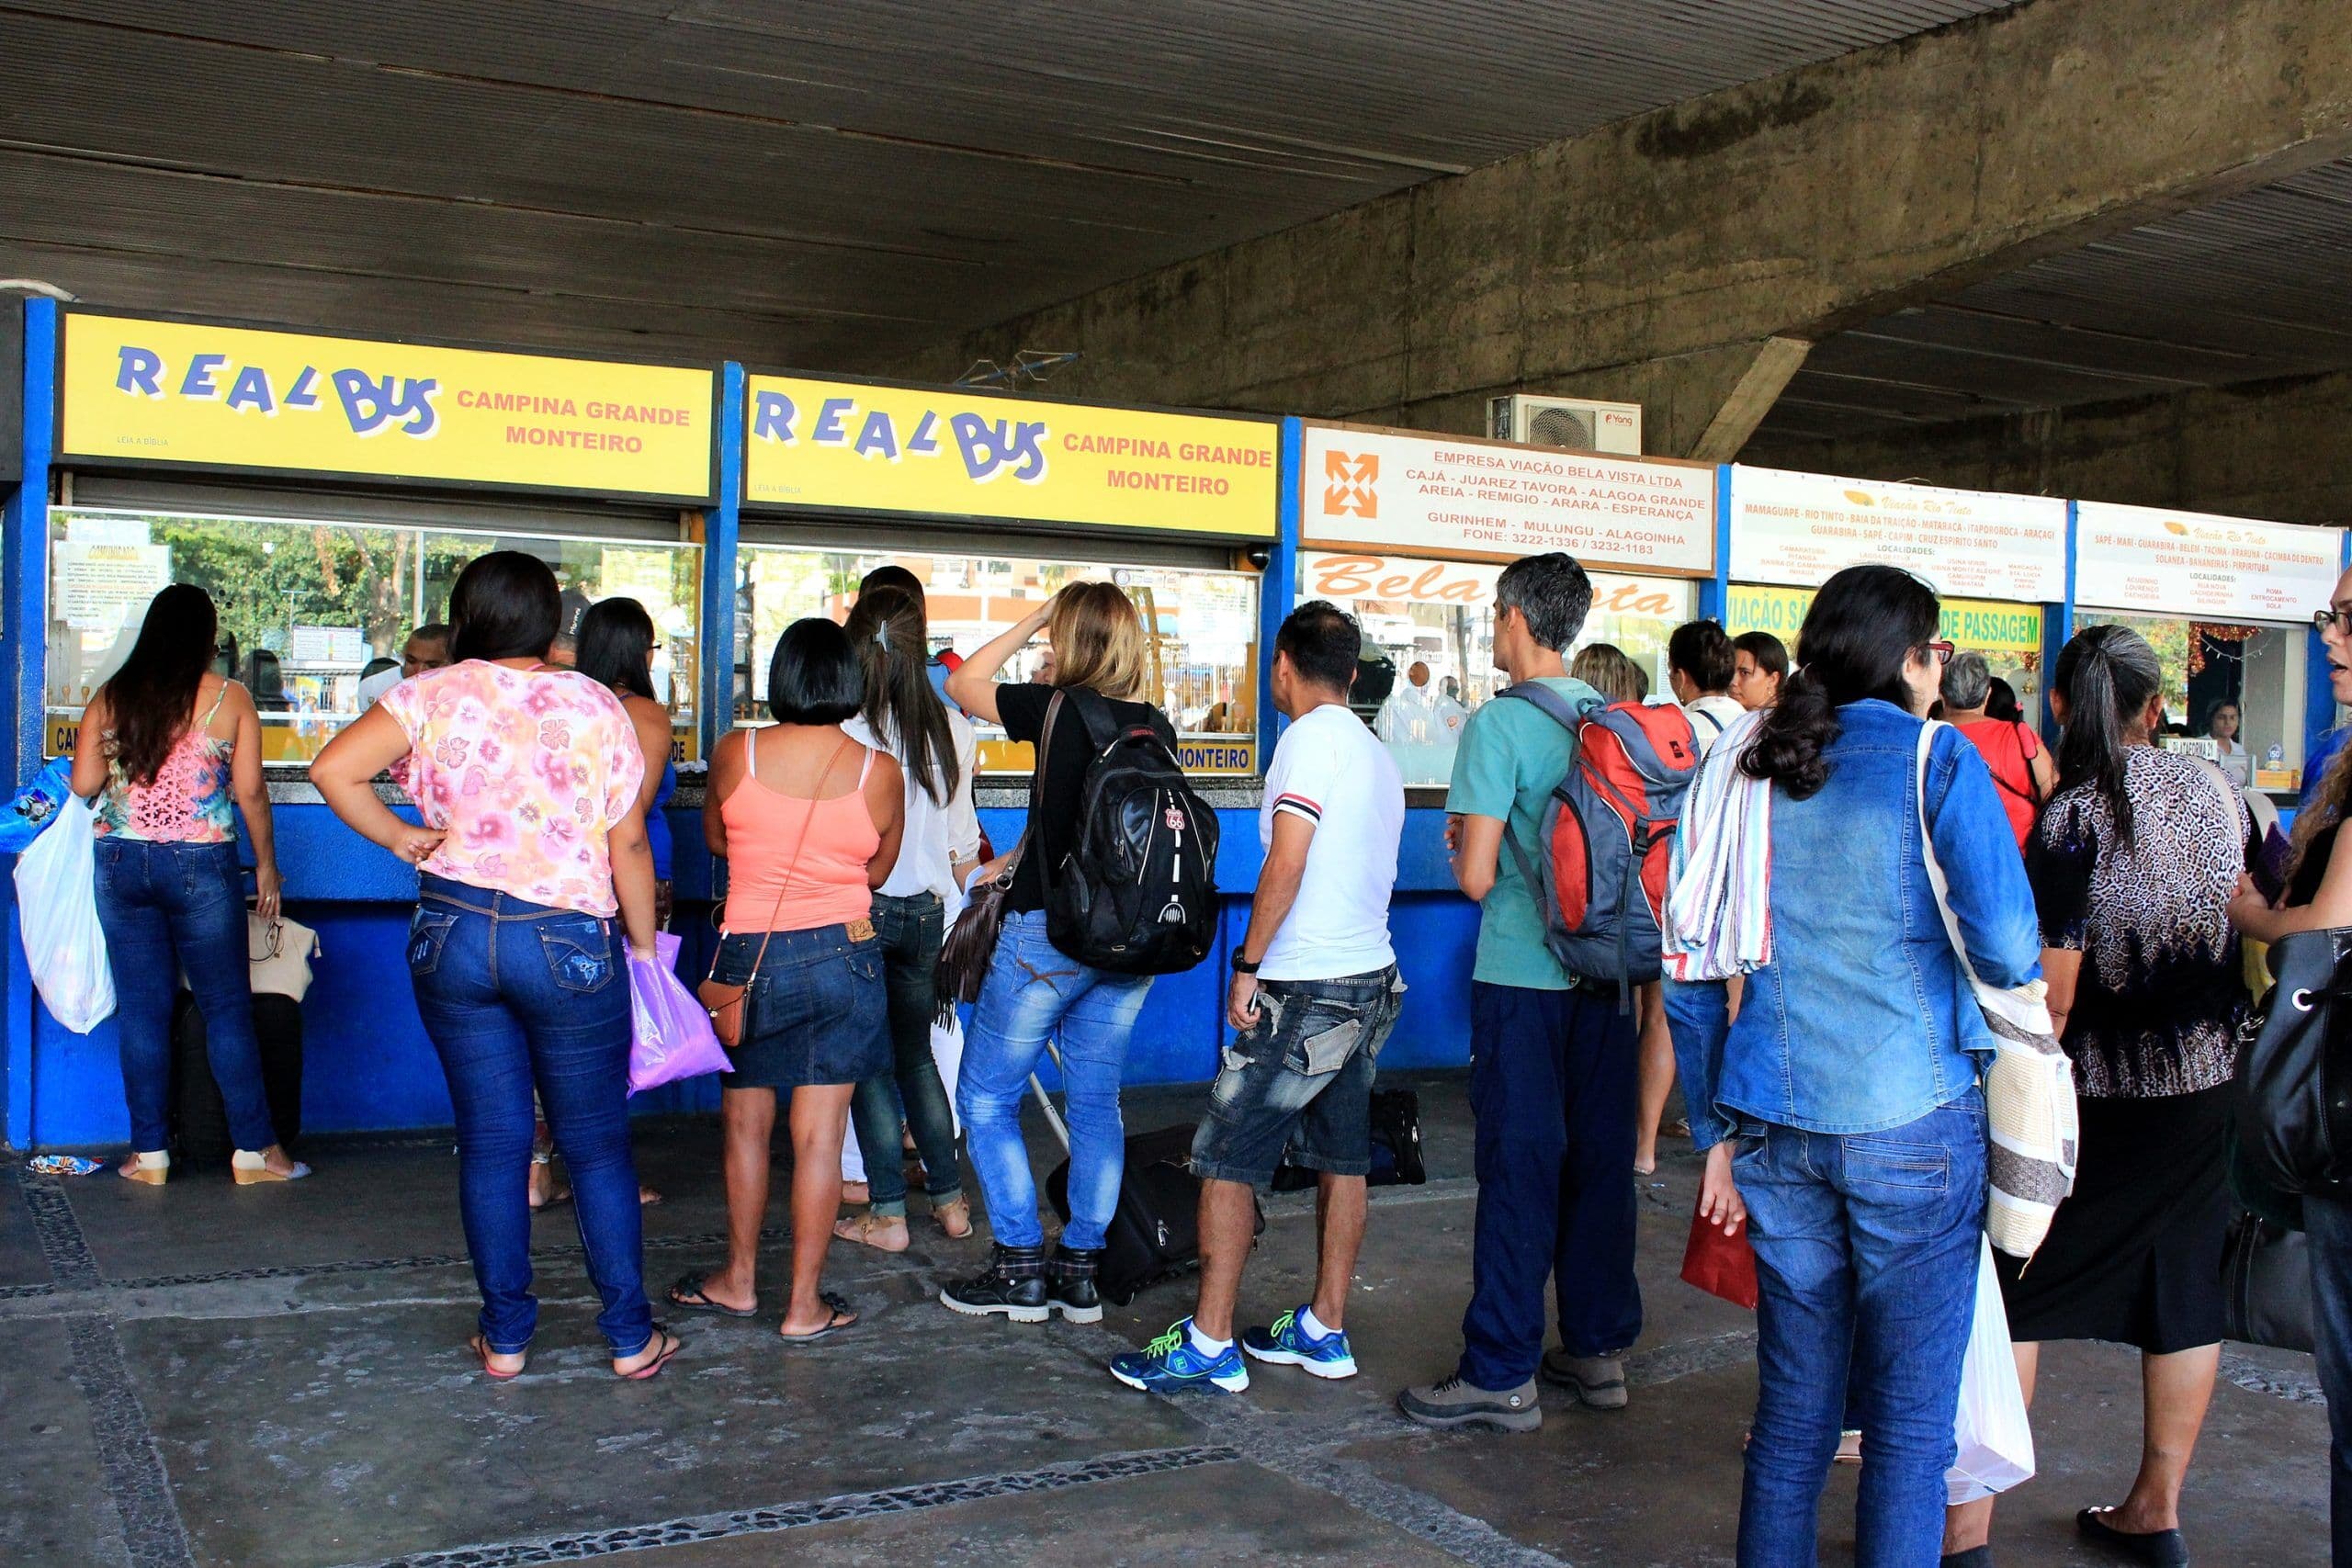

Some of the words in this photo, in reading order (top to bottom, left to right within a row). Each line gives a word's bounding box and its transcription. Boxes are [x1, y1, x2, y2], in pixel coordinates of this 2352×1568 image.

[116, 345, 320, 414] REAL
[457, 389, 577, 417] CAMPINA
[585, 401, 690, 426] GRANDE
[1613, 414, 1632, 426] Yang
[505, 425, 643, 453] MONTEIRO
[753, 390, 939, 460] REAL
[1063, 433, 1171, 458] CAMPINA
[1179, 443, 1272, 468] GRANDE
[1107, 469, 1229, 496] MONTEIRO
[1434, 451, 1505, 468] EMPRESA
[1510, 459, 1563, 475] VIAÇÃO
[1567, 466, 1604, 479] BELA
[1608, 470, 1645, 484] VISTA
[1649, 475, 1683, 489] LTDA
[1406, 469, 1446, 482] CAJÁ
[1460, 474, 1517, 490] JUAREZ
[1521, 480, 1577, 496] TAVORA
[1589, 488, 1646, 502] ALAGOA
[1650, 494, 1706, 510] GRANDE
[1419, 484, 1464, 497] AREIA
[1477, 490, 1539, 505] REMIGIO
[1551, 497, 1600, 511] ARARA
[1612, 503, 1694, 521] ESPERANÇA
[1428, 512, 1507, 528] GURINHEM
[1524, 521, 1594, 536] MULUNGU
[1606, 528, 1686, 545] ALAGOINHA
[1745, 504, 1799, 518] MAMAGUAPE
[1805, 510, 1819, 520] RIO
[1821, 511, 1844, 522] TINTO
[1850, 513, 1869, 524] BAIA
[1871, 515, 1882, 525] DA
[1464, 528, 1507, 542] FONE:
[1512, 534, 1579, 548] 3222-1336
[1590, 540, 1654, 554] 3232-1183
[1811, 525, 1857, 538] GUARABIRA
[1888, 532, 1913, 543] CAPIM
[1918, 534, 1938, 545] CRUZ
[1973, 538, 1998, 549] SANTO
[1877, 544, 1935, 556] LOCALIDADES:
[1313, 554, 1486, 602] Bela
[2189, 572, 2236, 583] LOCALIDADES:
[1788, 594, 1807, 630] SÃ
[1940, 611, 1960, 638] DE
[1964, 612, 2038, 643] PASSAGEM
[1170, 816, 1183, 829] 66
